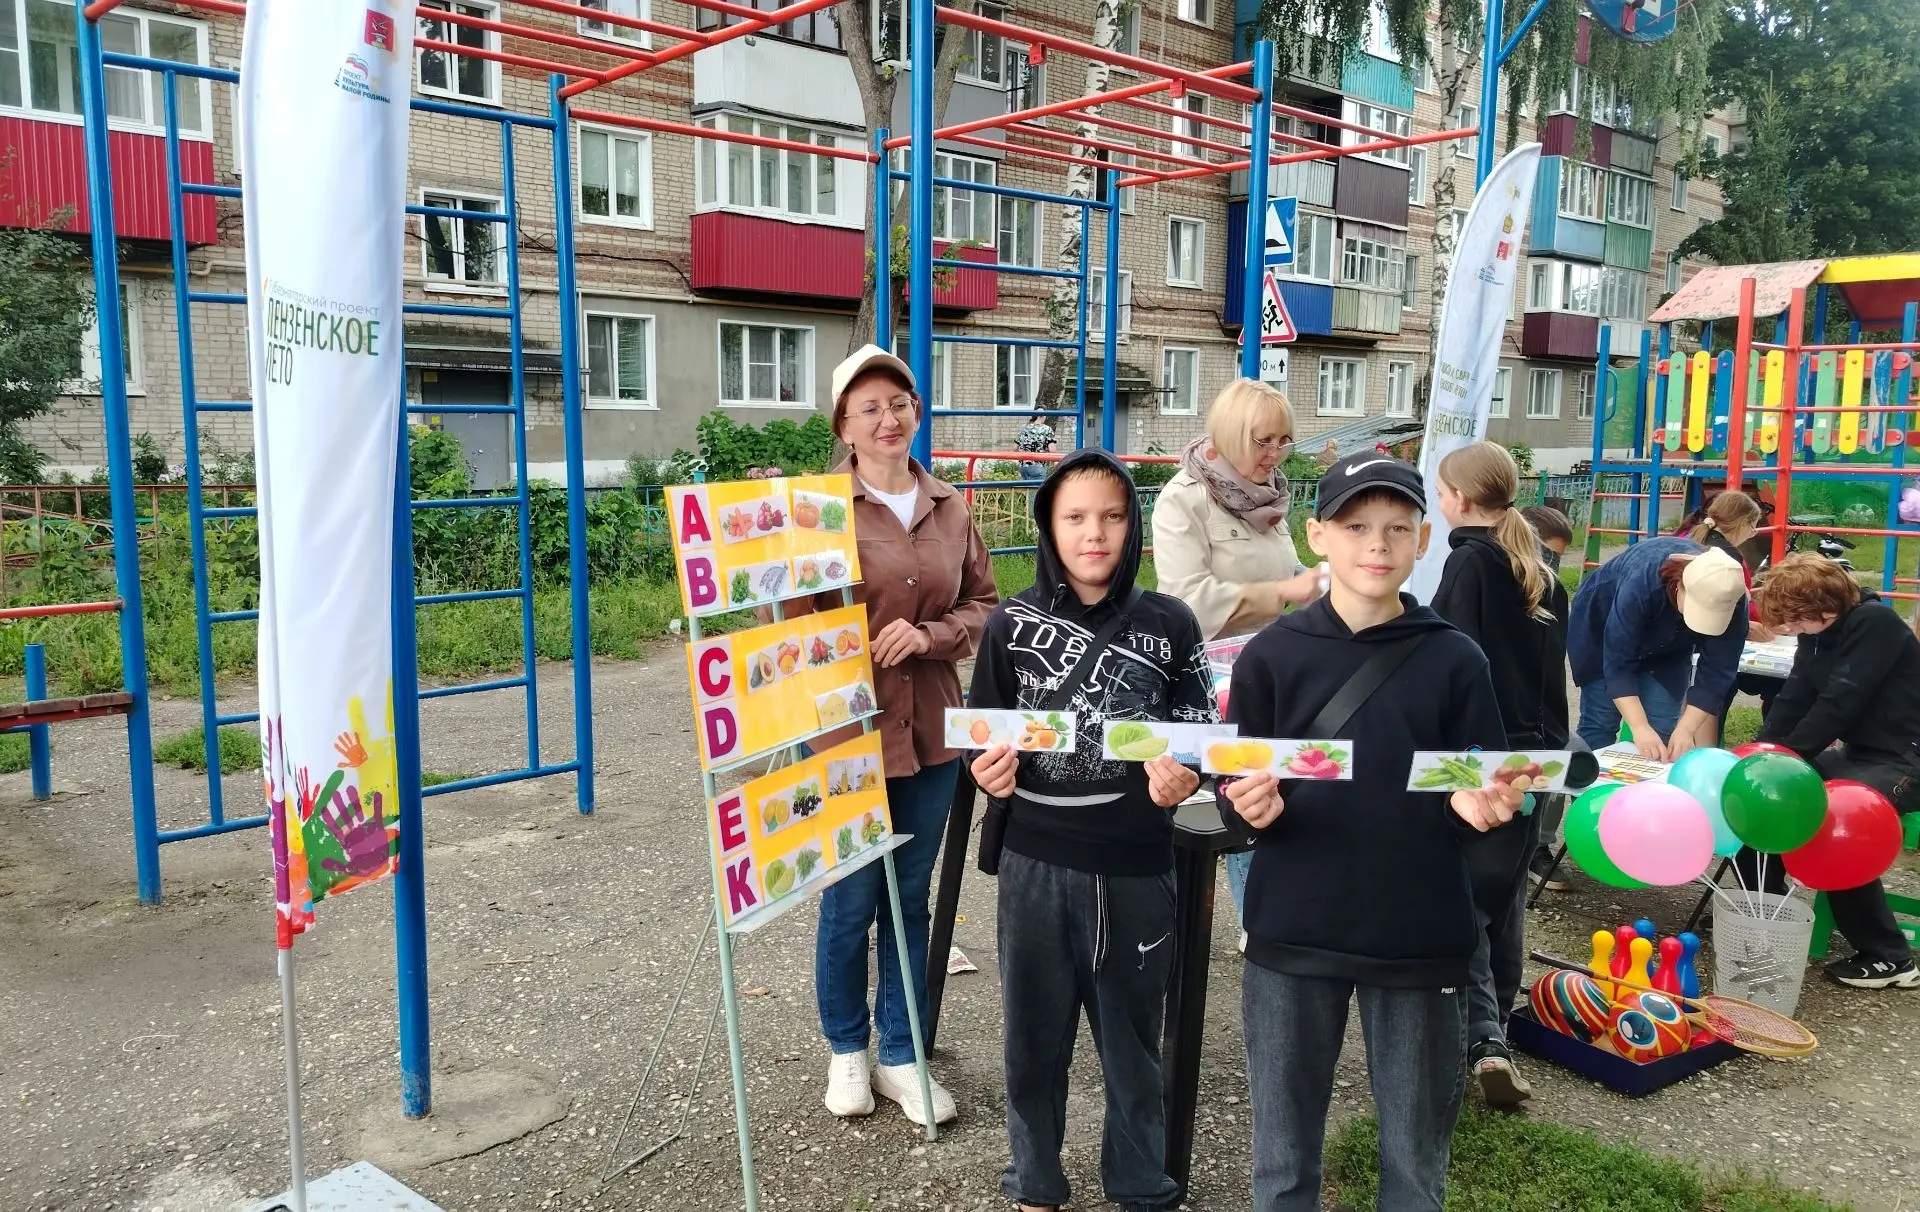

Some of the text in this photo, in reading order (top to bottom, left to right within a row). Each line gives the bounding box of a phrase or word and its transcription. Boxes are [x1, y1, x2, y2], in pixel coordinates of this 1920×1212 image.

[362, 91, 391, 104] РОДИНЫ
[267, 297, 380, 356] ПЕНЗЕНСКОЕ
[330, 300, 379, 316] проект
[265, 341, 293, 386] ЛЕТО
[681, 494, 711, 544] A
[686, 557, 717, 608] B
[699, 647, 731, 697] C
[705, 707, 737, 759] D
[718, 796, 746, 852] E
[726, 856, 757, 915] K
